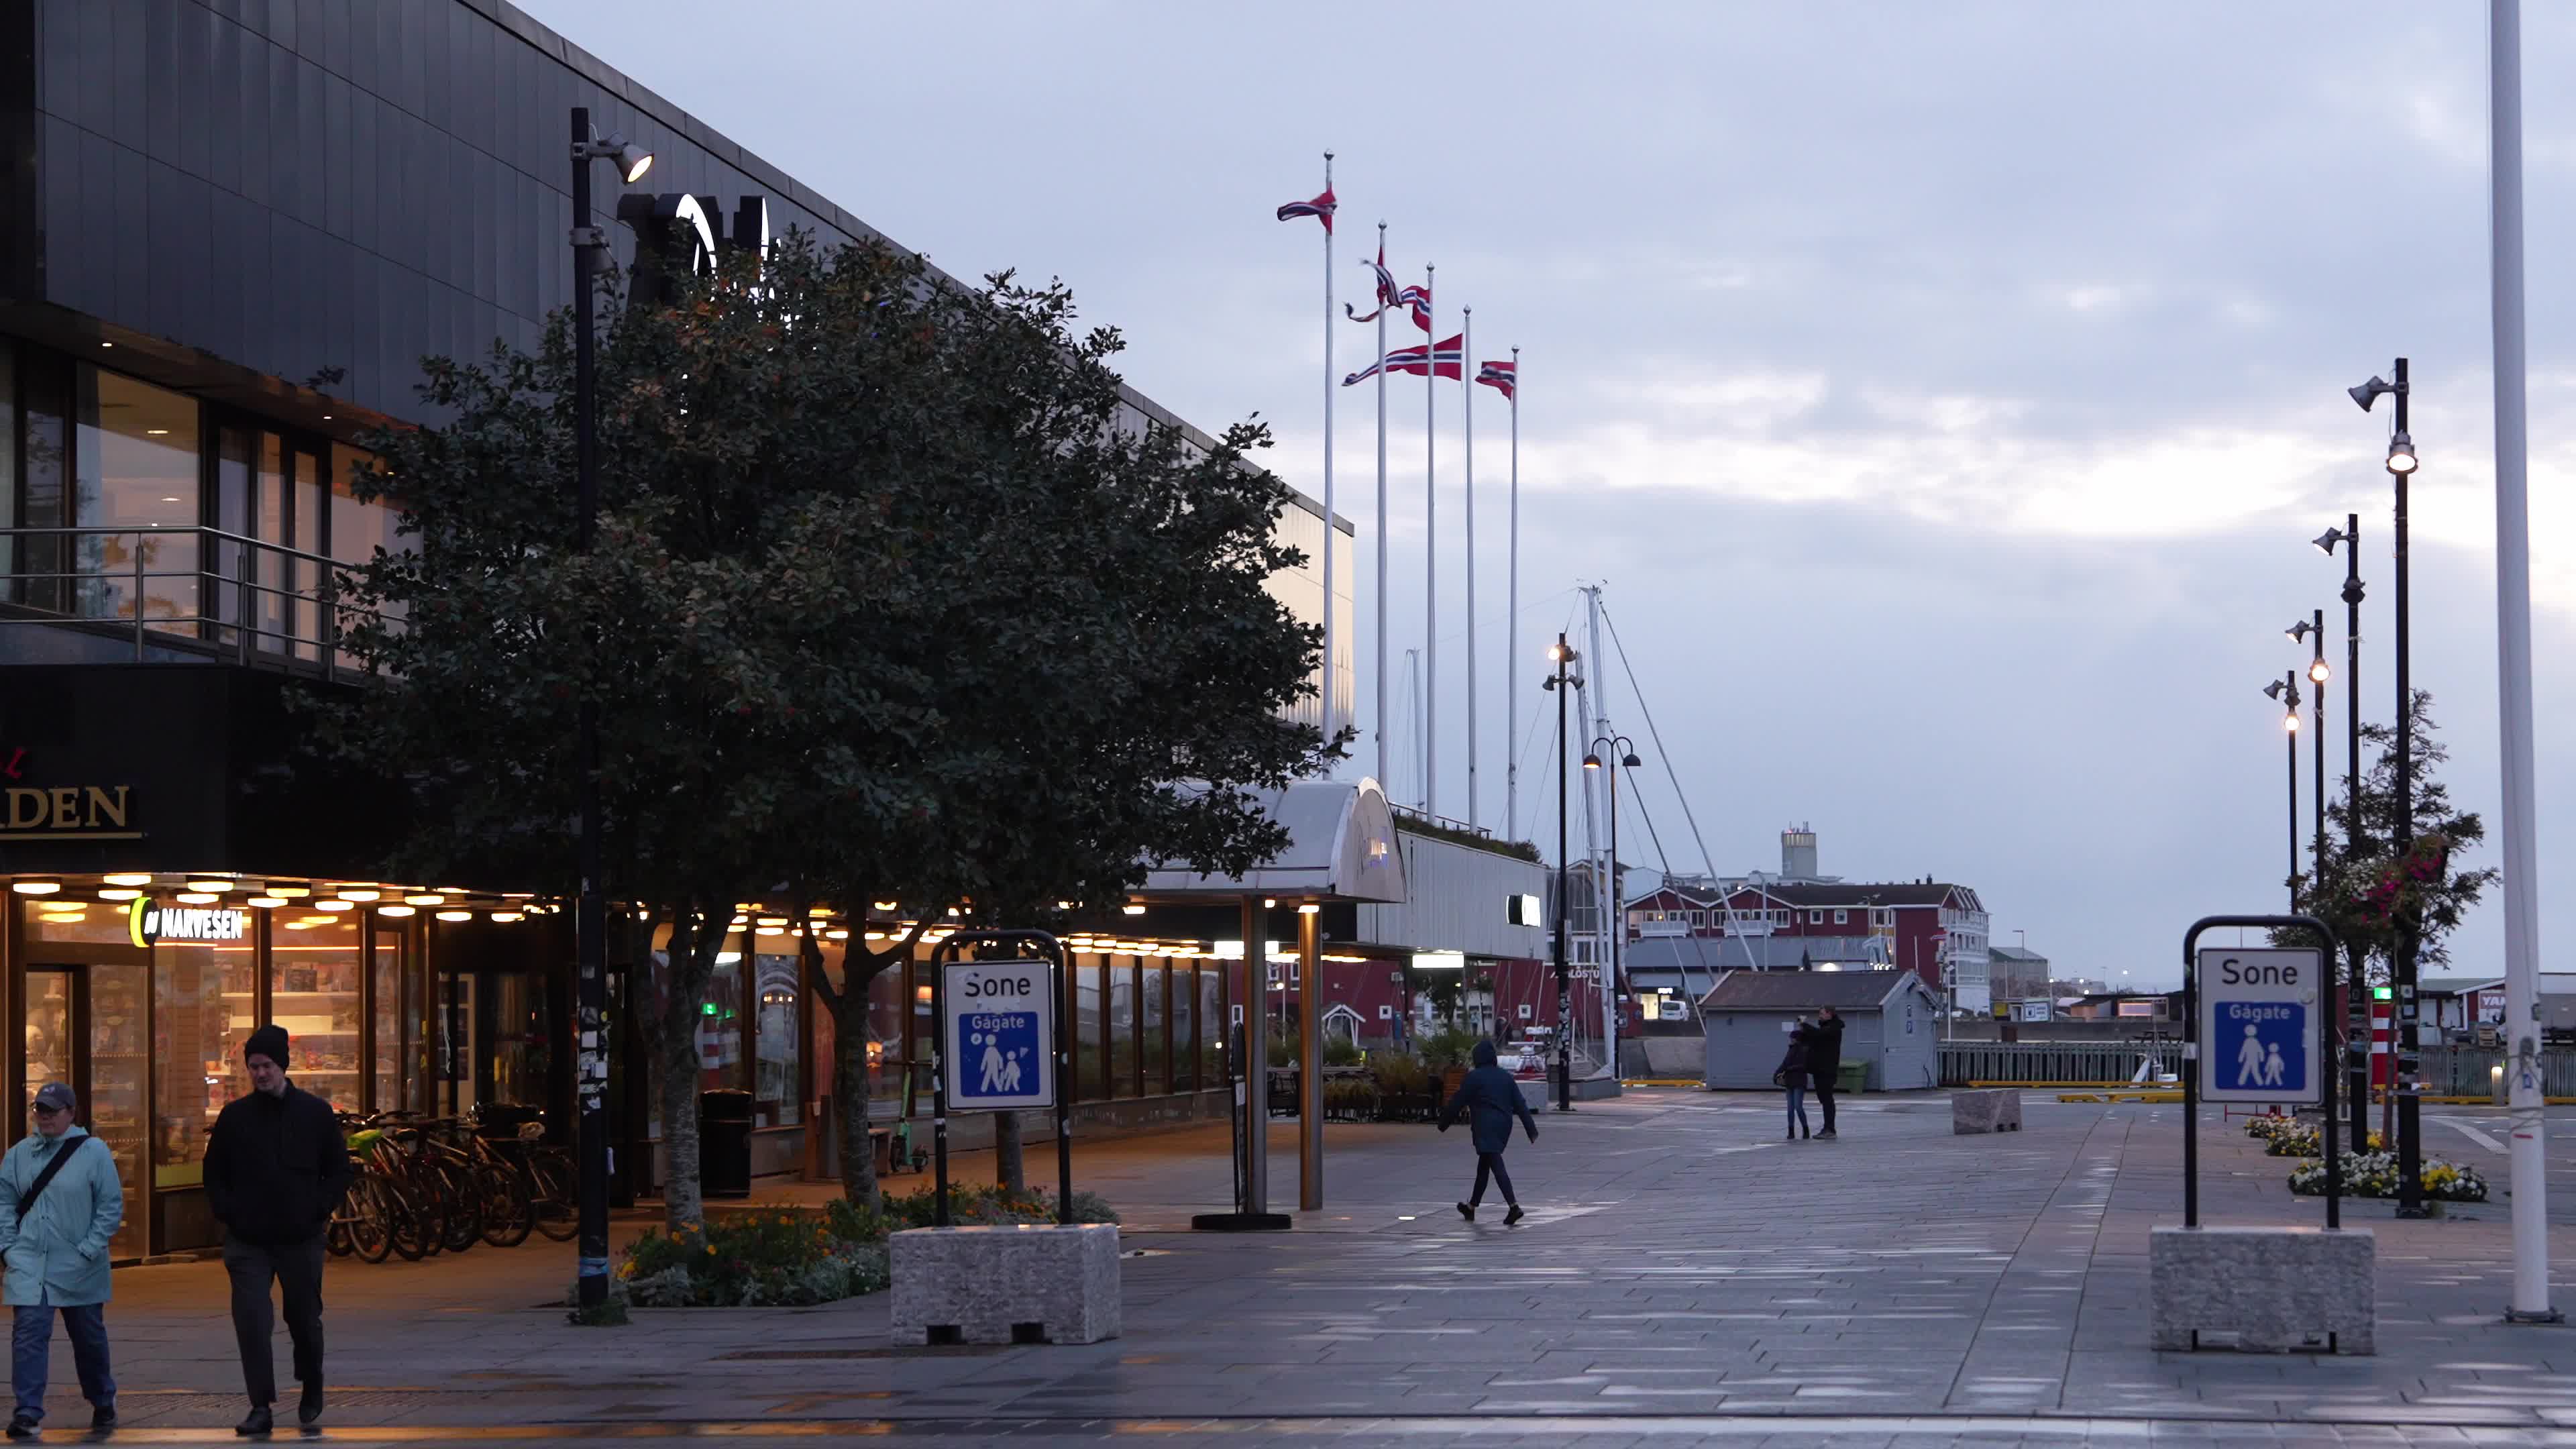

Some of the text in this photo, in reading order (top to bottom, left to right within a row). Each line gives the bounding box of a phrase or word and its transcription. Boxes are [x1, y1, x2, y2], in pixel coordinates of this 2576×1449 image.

[0, 786, 129, 828] DEN
[161, 908, 243, 939] NARVESEN
[2221, 958, 2298, 985] Sone
[964, 972, 1031, 998] Sone
[971, 1014, 1025, 1032] Gågate
[2229, 1004, 2291, 1023] Gågate
